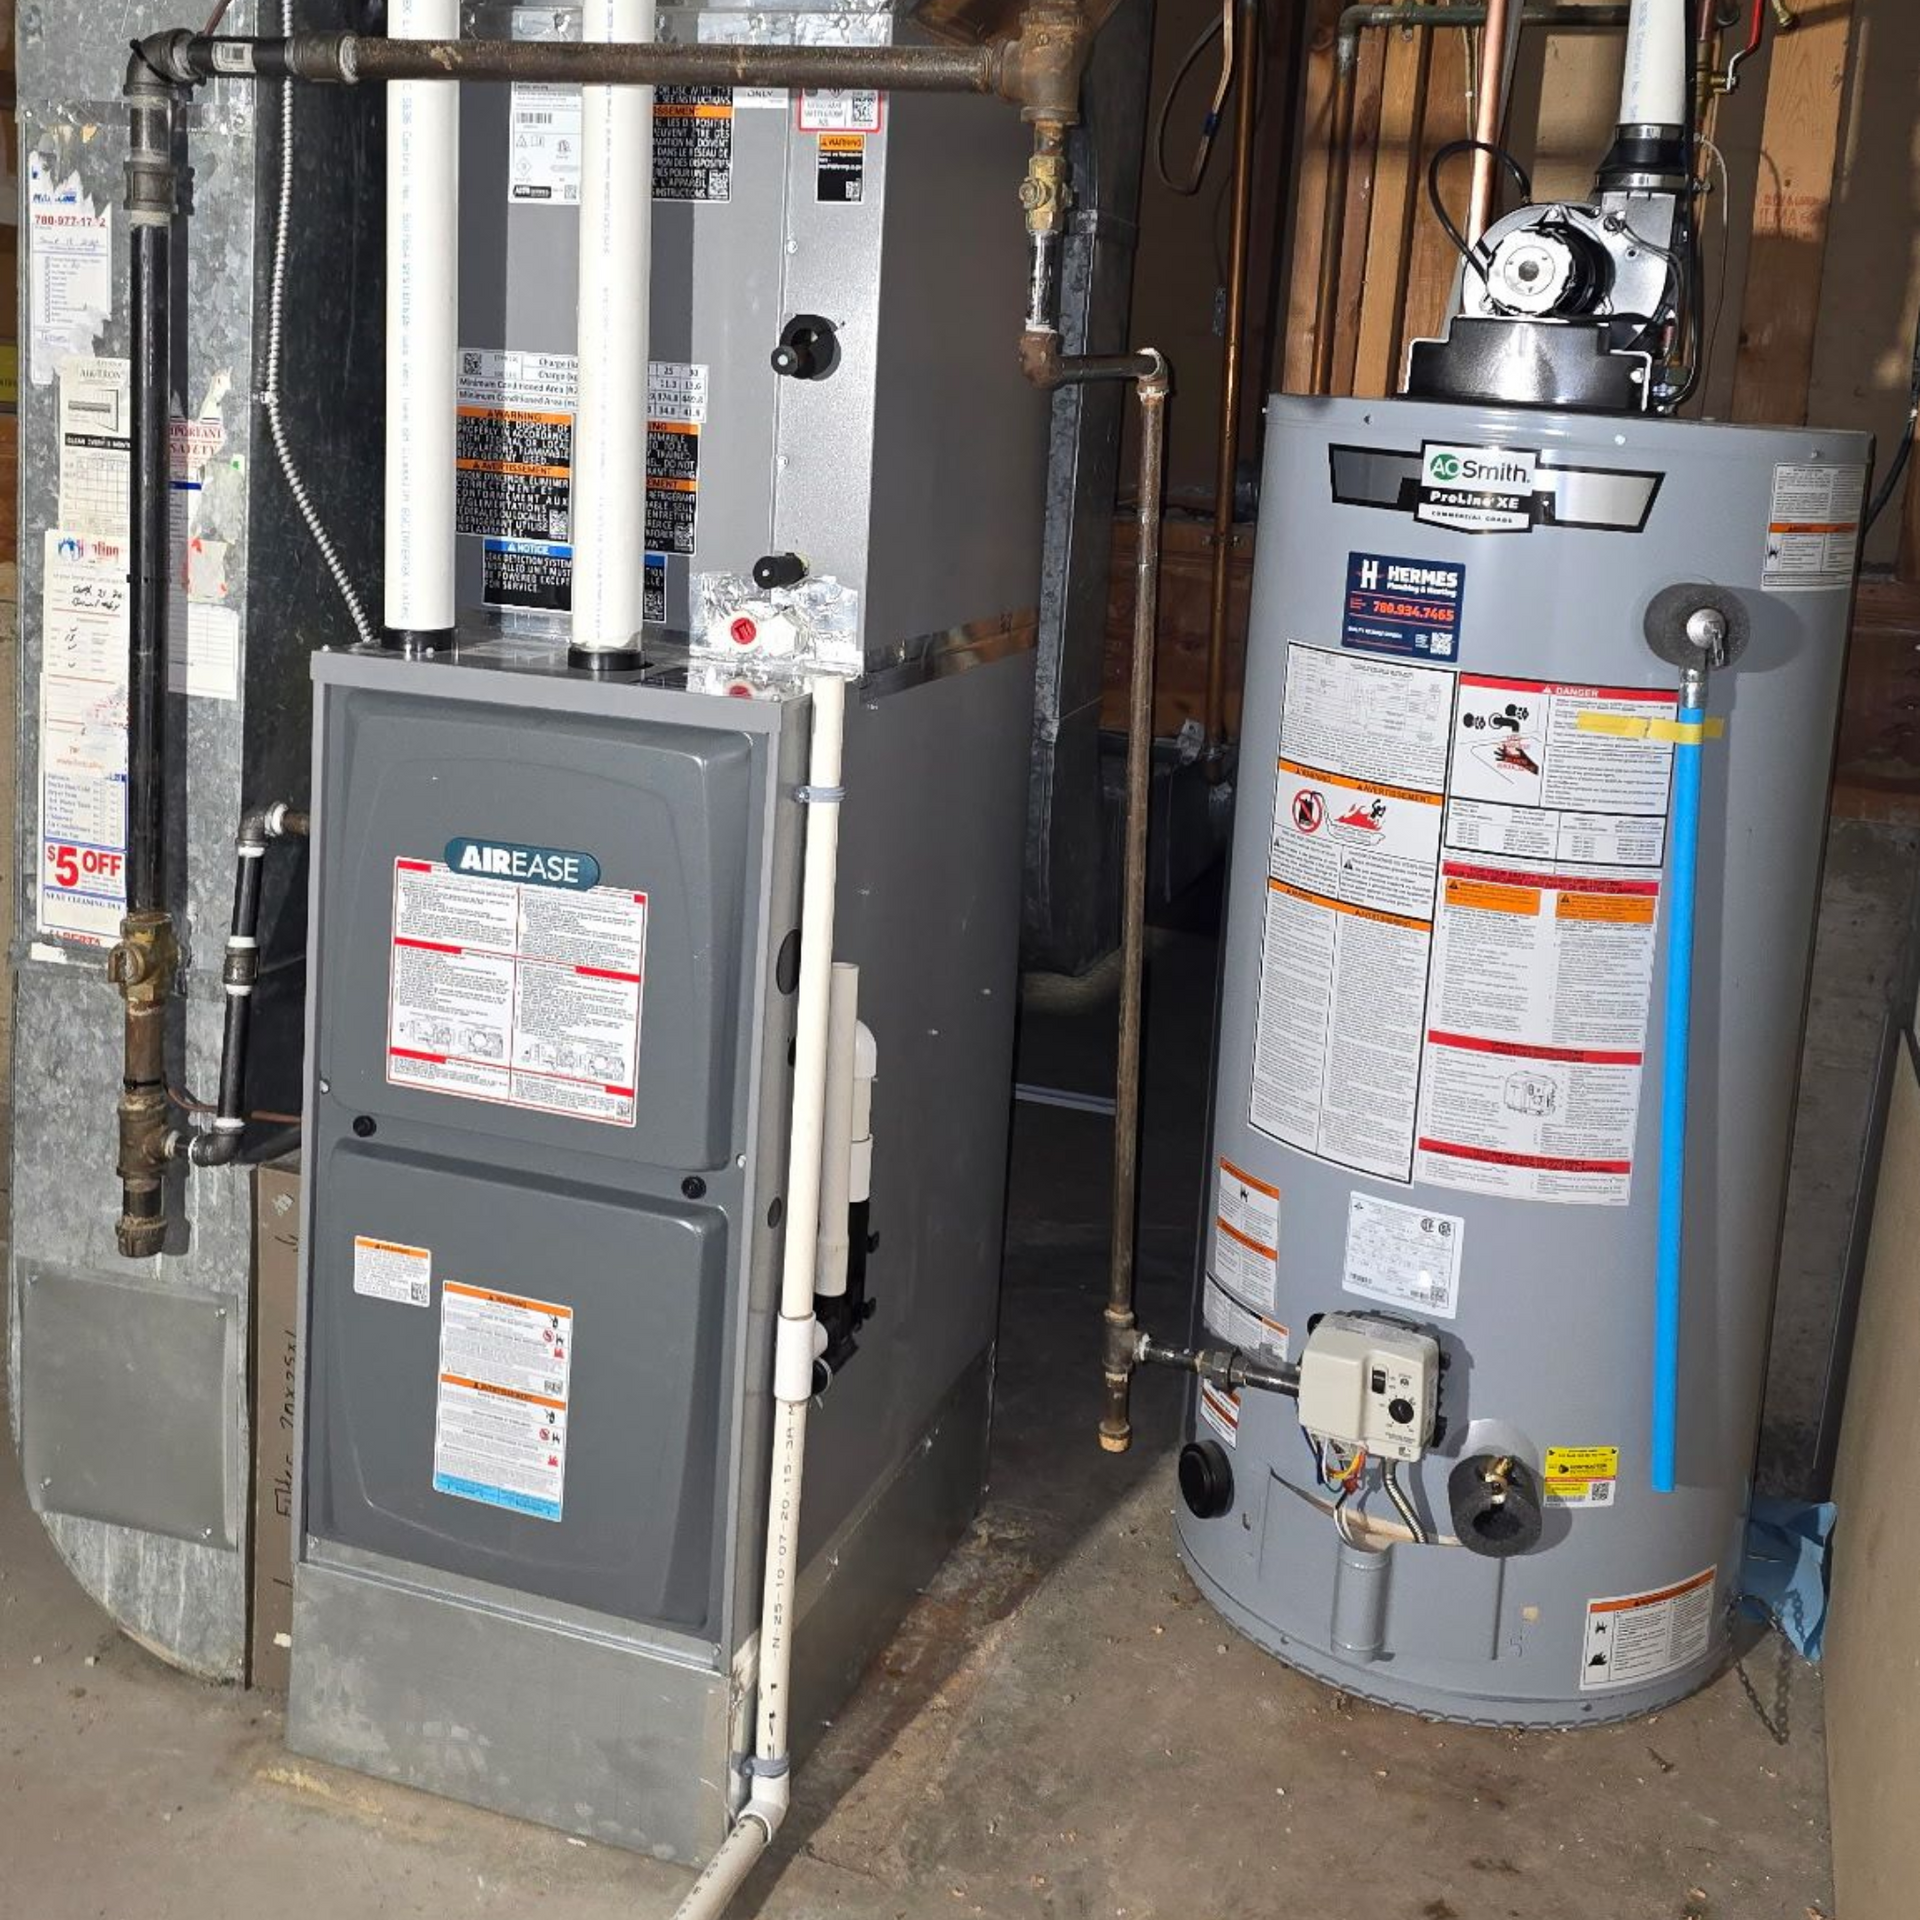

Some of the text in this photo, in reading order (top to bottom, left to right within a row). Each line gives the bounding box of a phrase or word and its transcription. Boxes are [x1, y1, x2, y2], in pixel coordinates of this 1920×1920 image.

[34, 214, 106, 227] 780-977-172
[664, 367, 673, 375] 25
[459, 378, 496, 388] Minimum
[497, 379, 544, 392] Conditioned
[546, 384, 563, 393] Area
[459, 390, 495, 400] Minimum
[497, 392, 544, 404] Conditioned
[493, 410, 542, 421] WARNING
[513, 430, 570, 441] ACCORDANCE
[482, 460, 552, 474] AVERTISSEMENT
[664, 459, 695, 470] DO NOT
[546, 495, 568, 505] AUX
[1430, 491, 1519, 508] ProLine XE
[517, 543, 549, 554] NOTICE
[503, 554, 542, 565] DETECTION
[545, 558, 572, 568] SYSTEM
[1388, 566, 1458, 587] HERMES
[1387, 582, 1419, 594] Plumbing
[1427, 587, 1457, 598] Heating
[1373, 600, 1455, 621] 780.934.7465
[1555, 687, 1599, 697] DANGER
[1363, 784, 1432, 803] AVERTISSEMENT
[47, 845, 122, 887] $5 OFF
[459, 844, 580, 883] AIREASE
